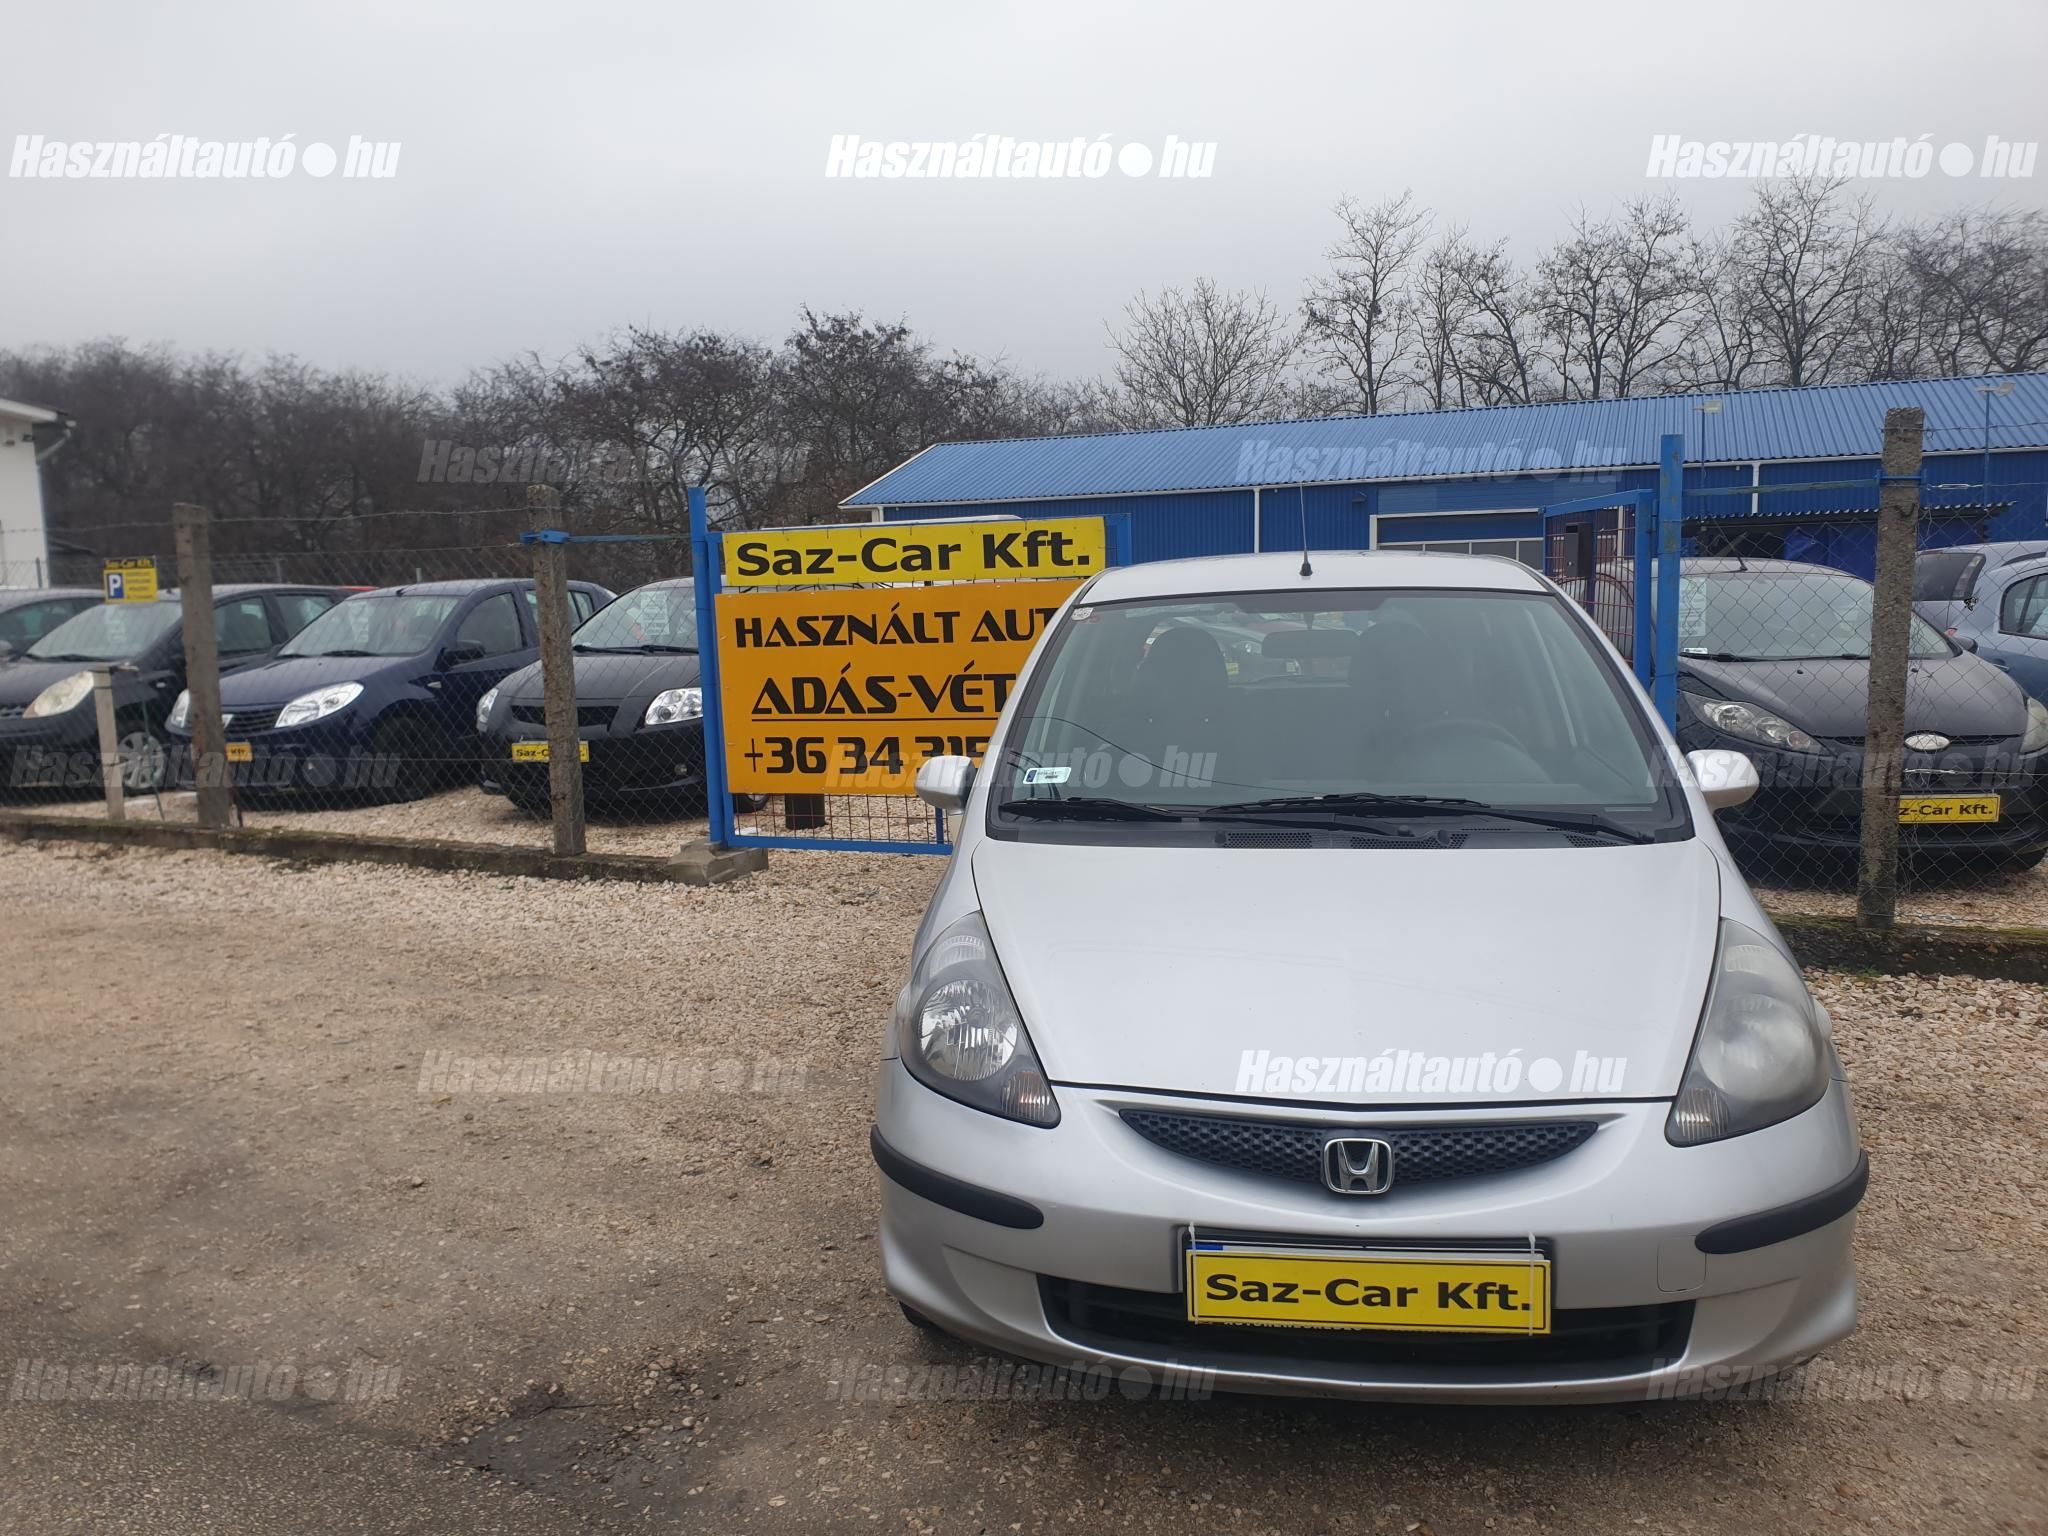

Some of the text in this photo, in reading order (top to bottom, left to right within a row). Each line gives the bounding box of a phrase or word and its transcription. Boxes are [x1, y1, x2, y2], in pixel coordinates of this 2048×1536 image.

[737, 529, 1090, 577] Saz-Car Kft.
[735, 602, 960, 648] HASZNÁLT
[744, 736, 827, 775] +36
[837, 736, 904, 775] 34
[1959, 804, 1993, 816] Kft.
[1206, 1273, 1533, 1312] Saz-Car Kft.
